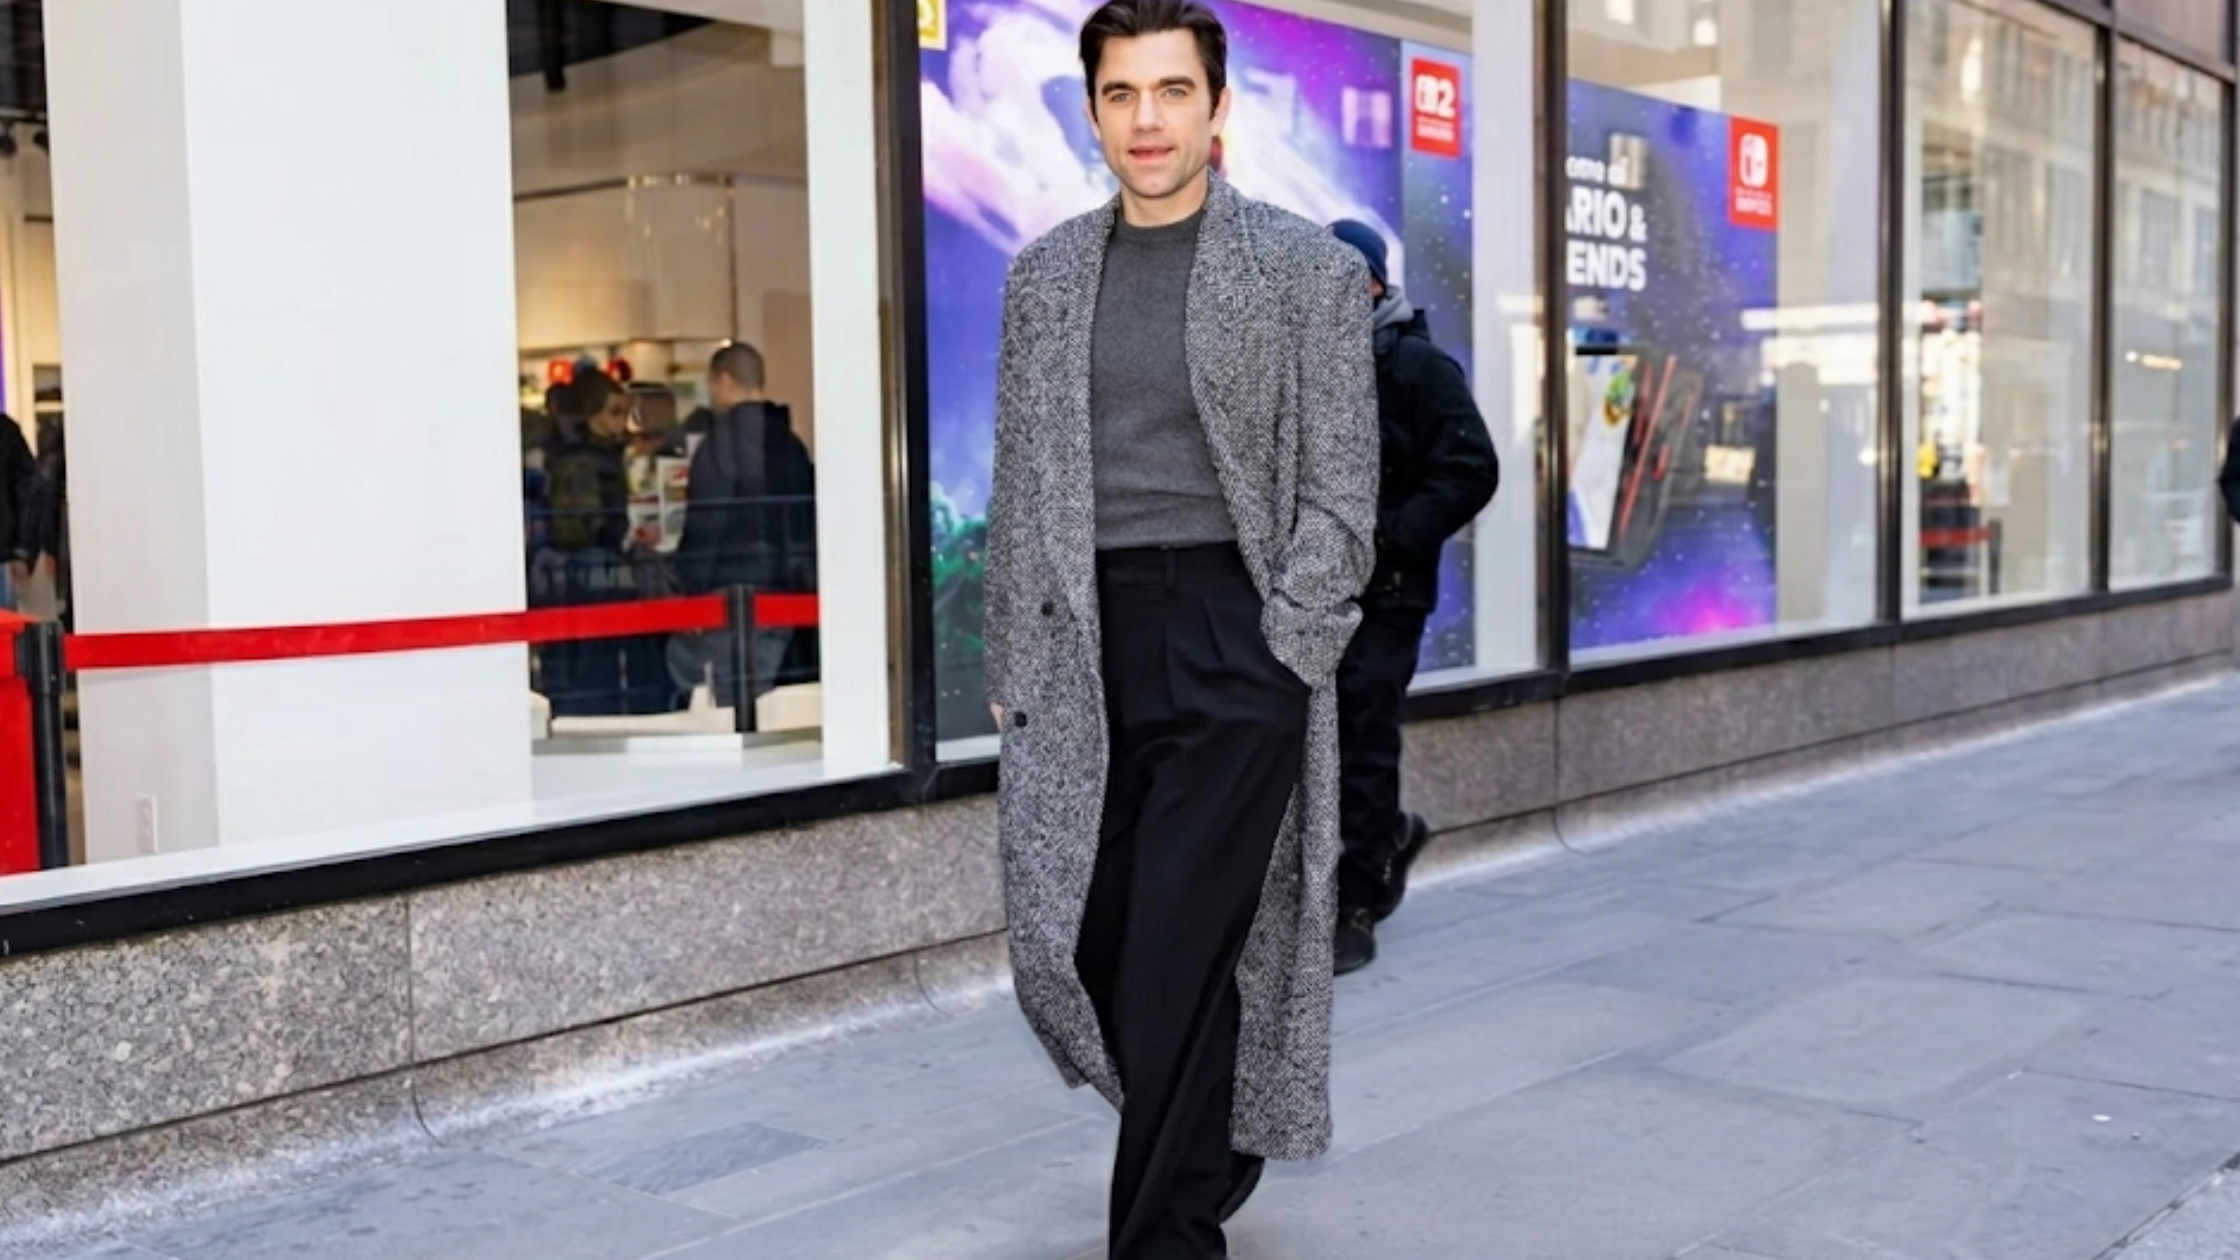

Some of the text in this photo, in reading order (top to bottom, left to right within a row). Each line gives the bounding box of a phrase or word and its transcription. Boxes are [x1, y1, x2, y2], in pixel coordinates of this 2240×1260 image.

[1438, 78, 1456, 118] 2
[1629, 204, 1647, 242] &
[1566, 239, 1647, 291] ENDS
